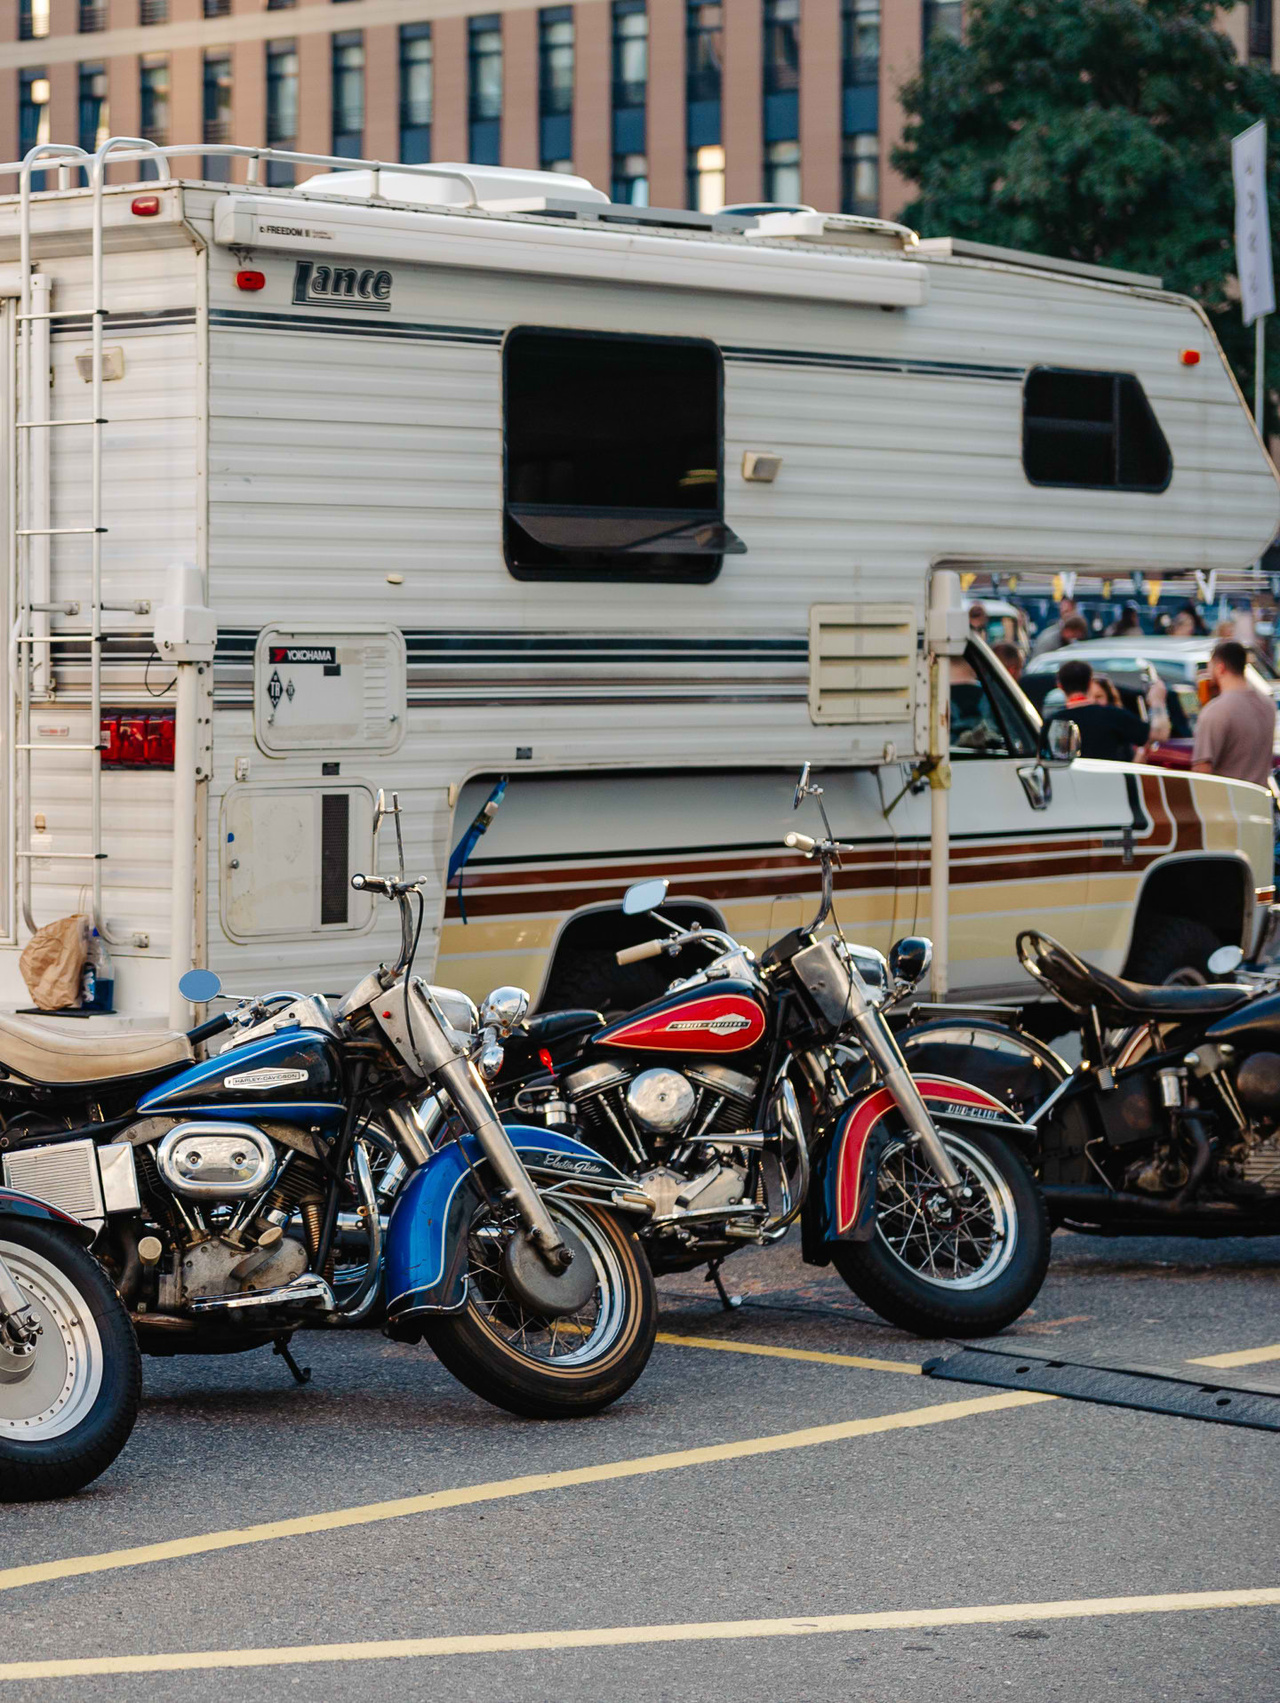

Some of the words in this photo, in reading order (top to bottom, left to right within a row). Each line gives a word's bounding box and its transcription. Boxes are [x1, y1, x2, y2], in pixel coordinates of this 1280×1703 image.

[266, 225, 303, 237] FREEDOM
[292, 260, 393, 312] Lance
[287, 649, 332, 661] YOKOHAMA
